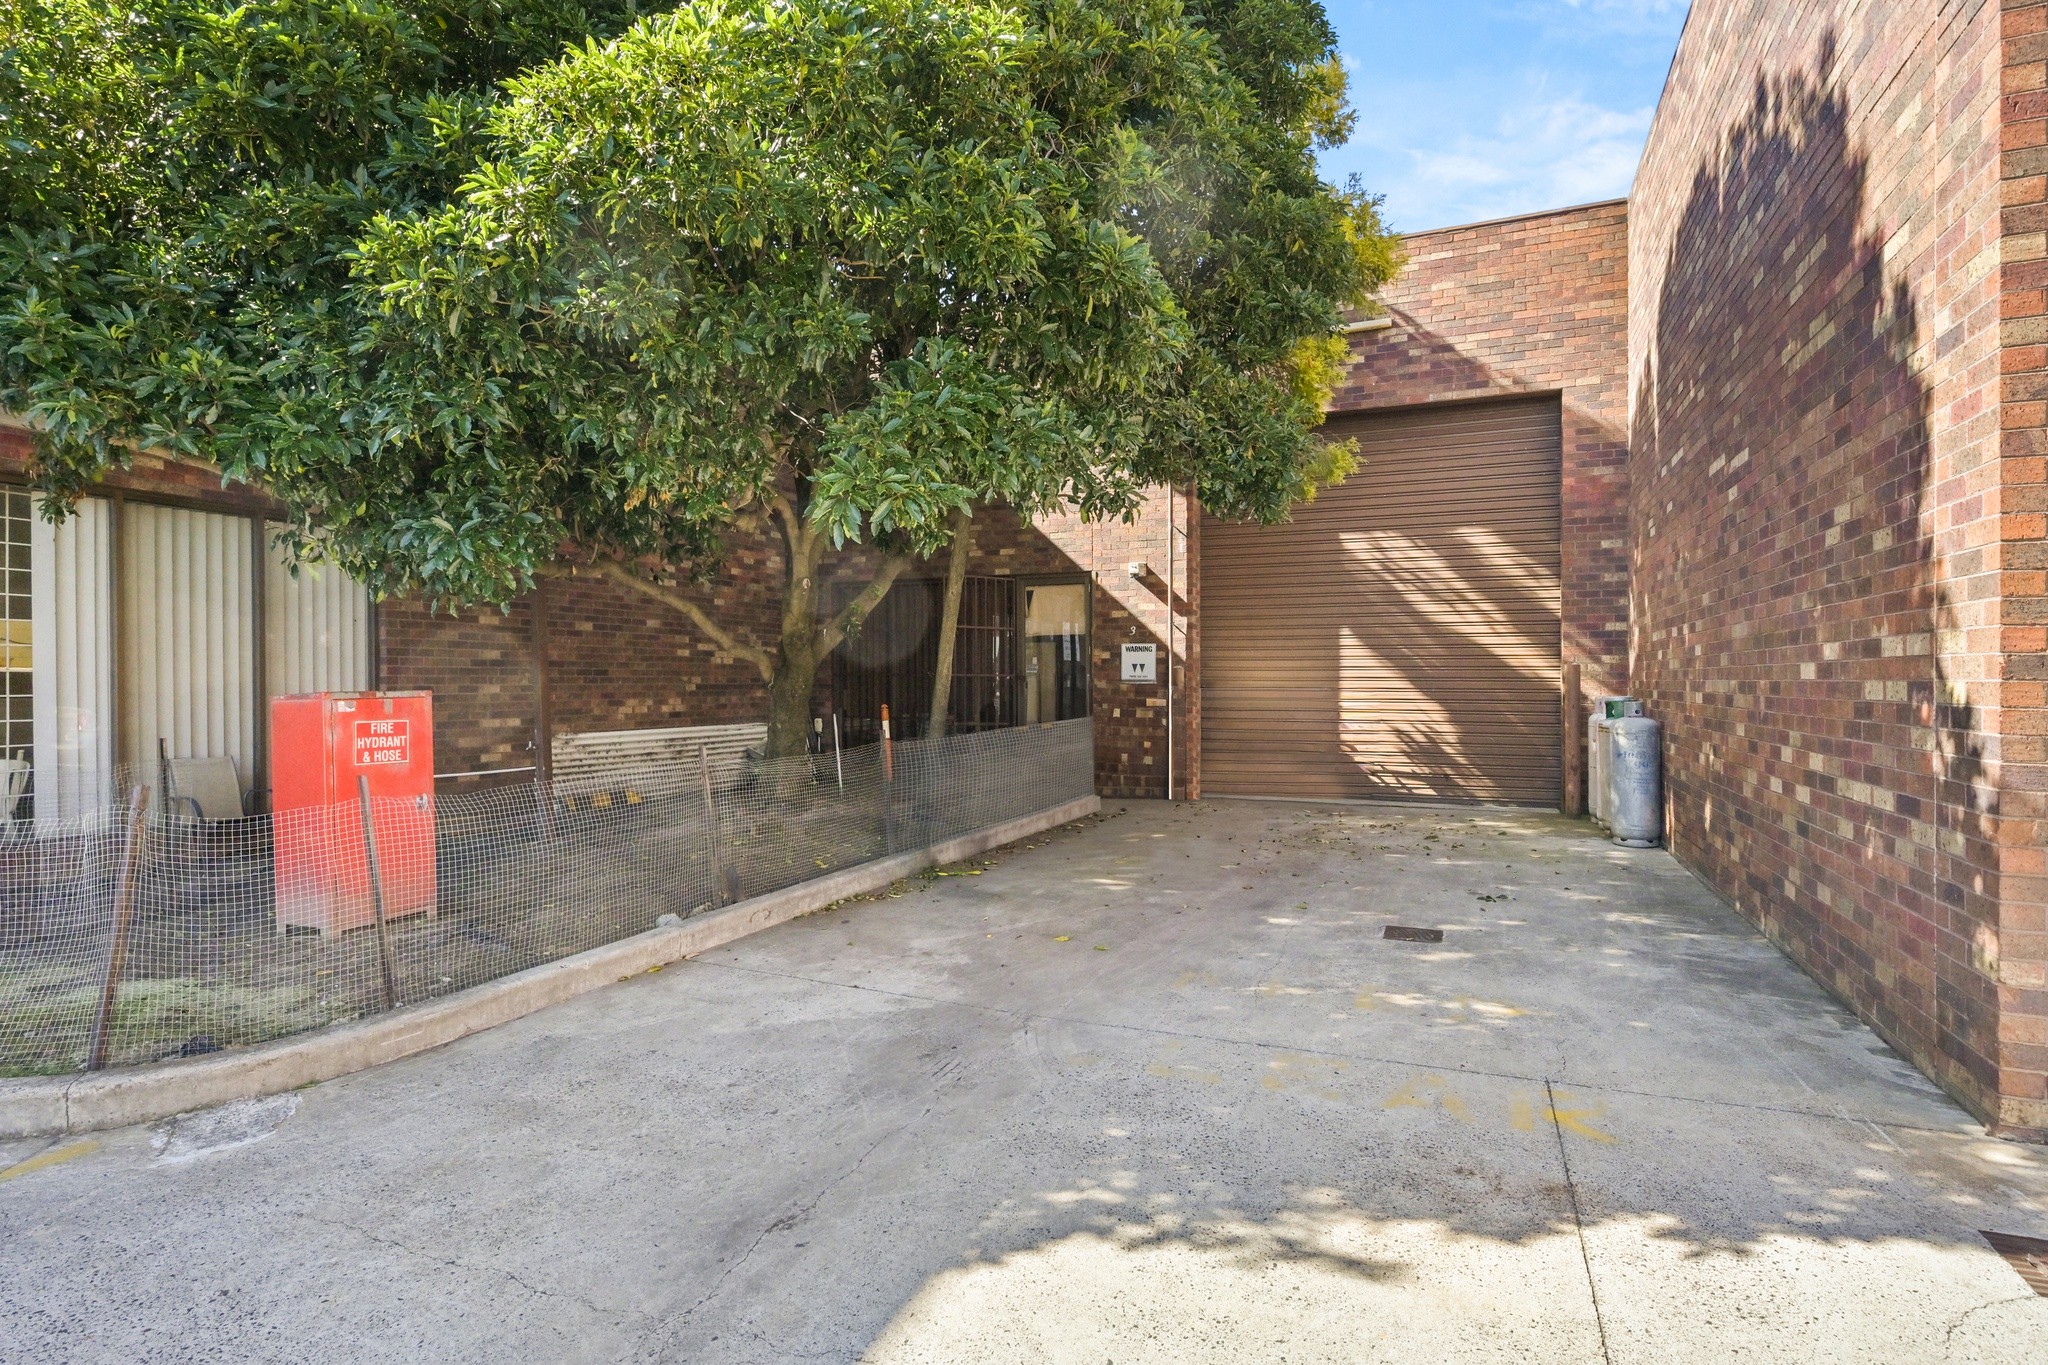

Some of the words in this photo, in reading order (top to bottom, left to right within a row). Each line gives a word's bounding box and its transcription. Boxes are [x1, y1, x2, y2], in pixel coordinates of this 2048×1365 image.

[1129, 626, 1136, 636] 3
[1125, 645, 1153, 653] WARNING
[370, 722, 394, 734] FIRE
[357, 735, 407, 749] HYDRANT
[363, 751, 371, 763] &
[374, 749, 402, 762] HOSE
